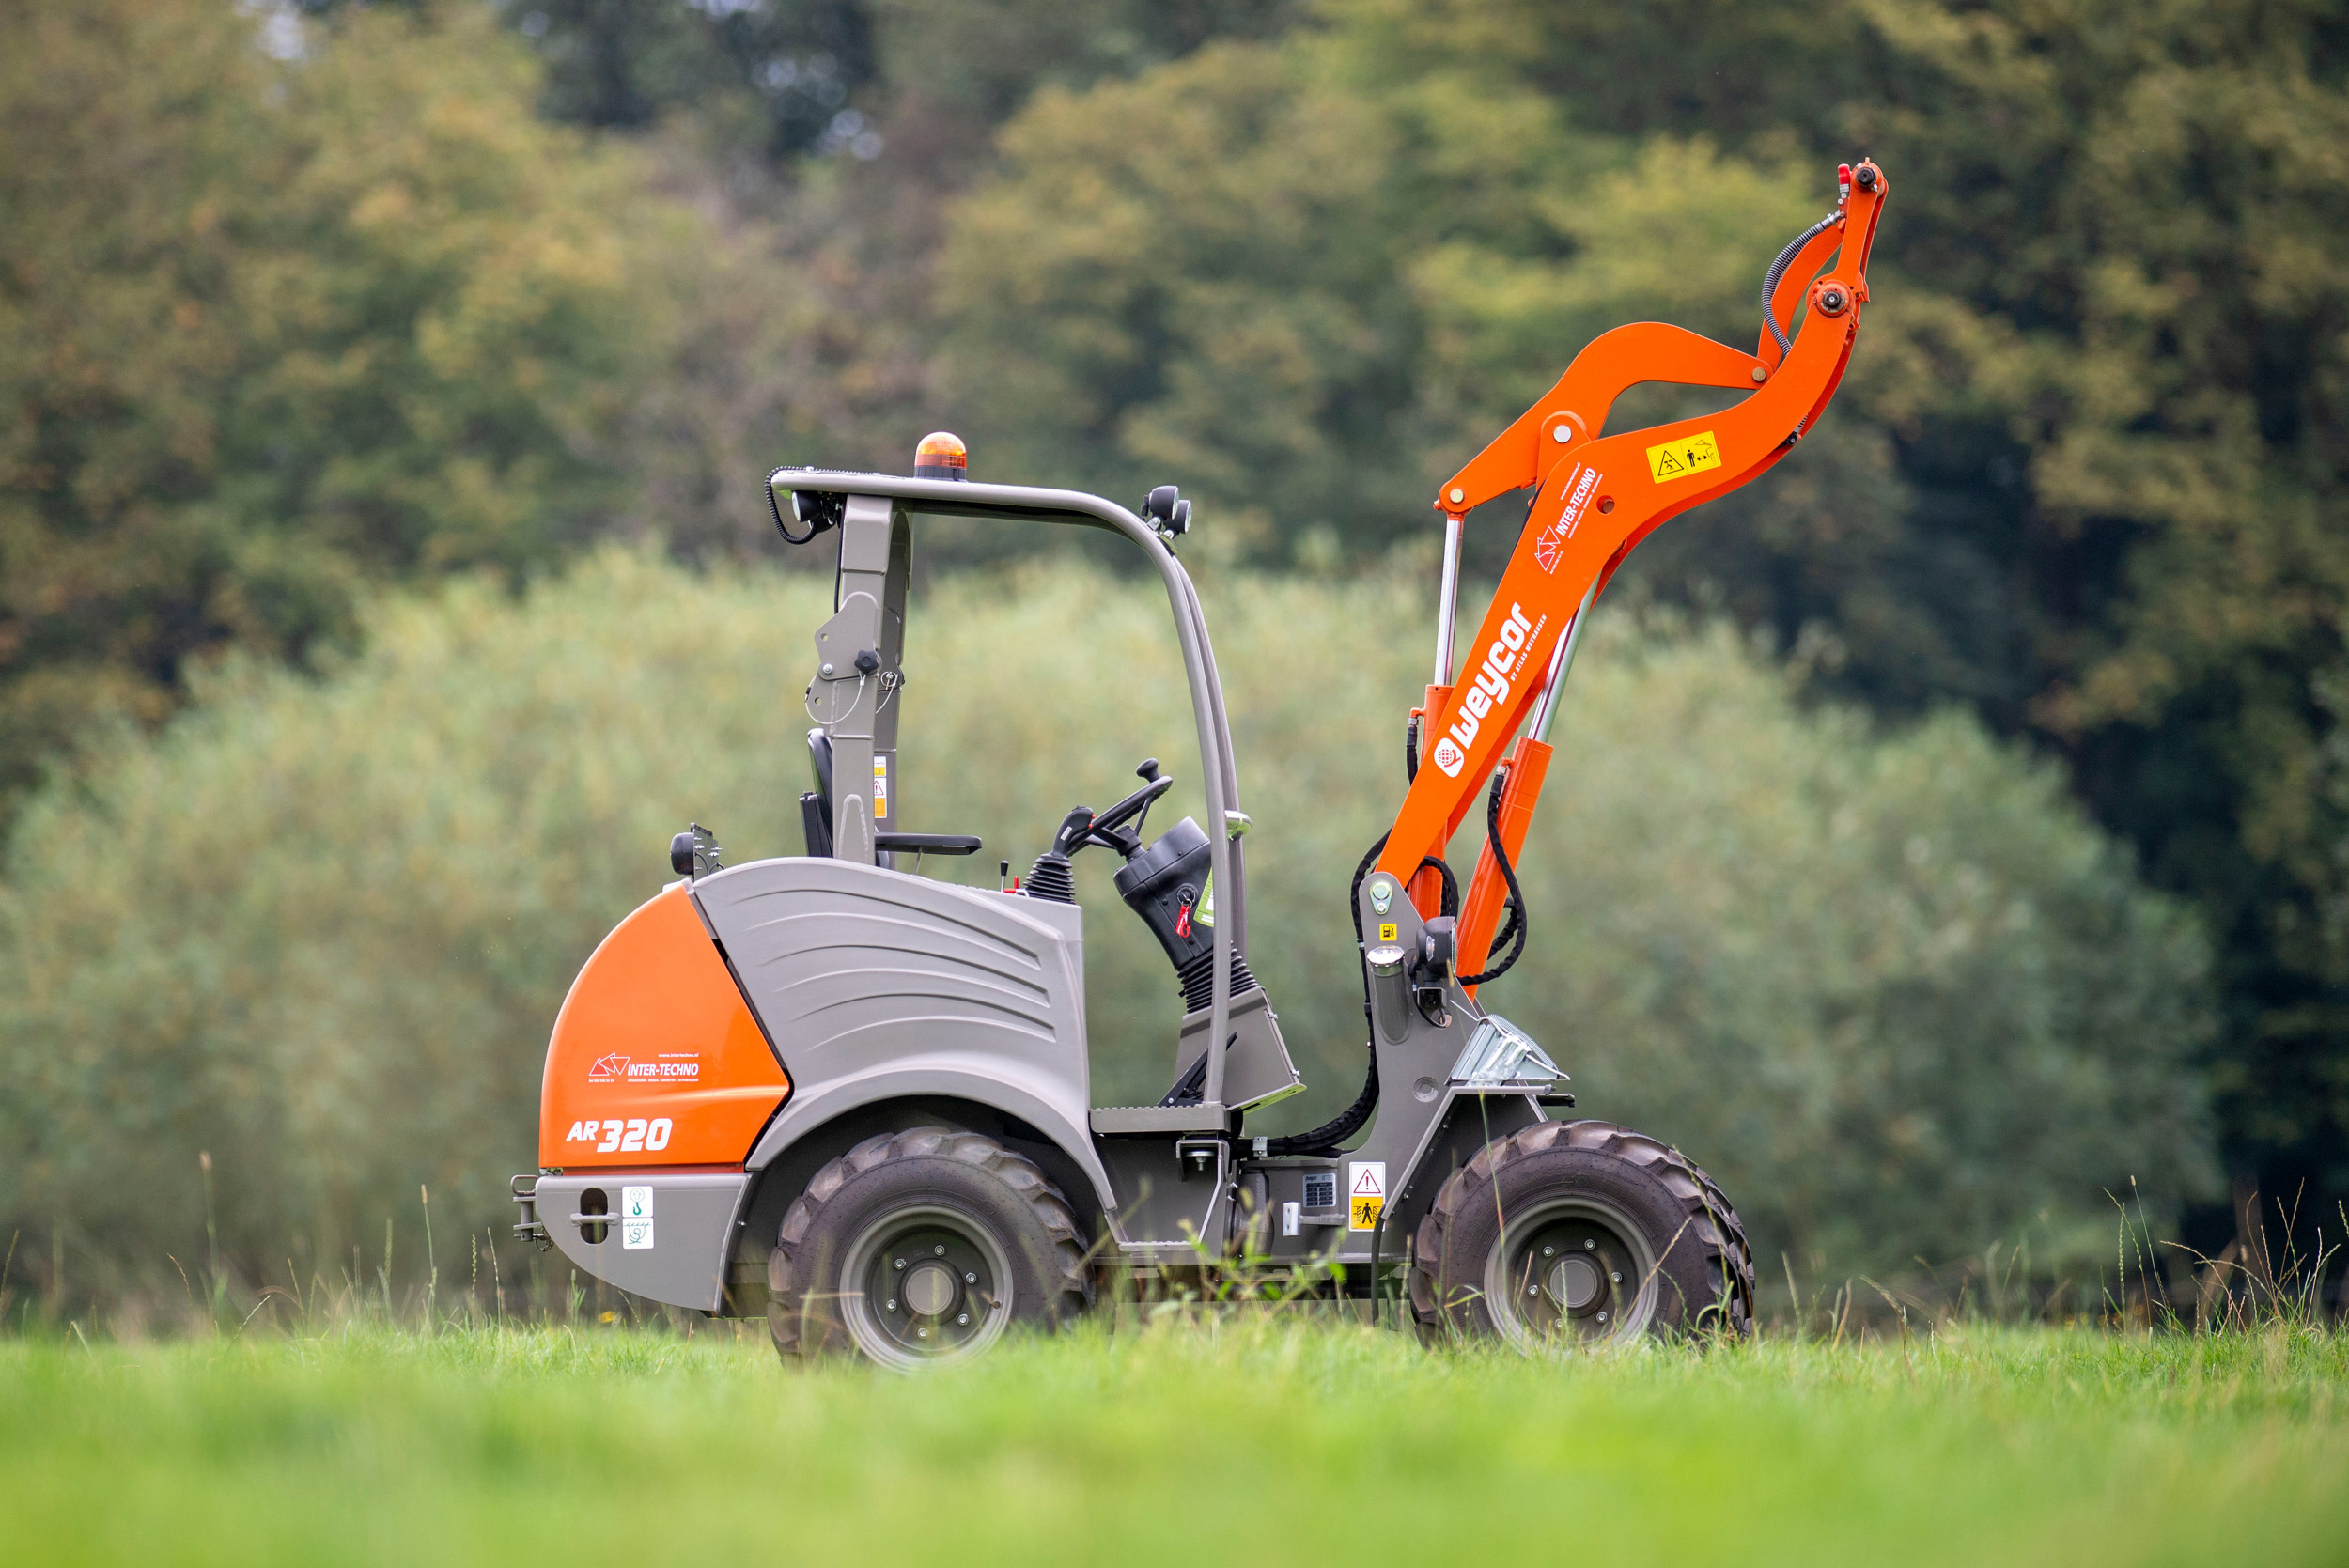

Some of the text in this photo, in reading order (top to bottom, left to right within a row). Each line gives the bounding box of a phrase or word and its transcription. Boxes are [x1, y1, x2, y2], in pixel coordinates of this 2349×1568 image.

[1555, 466, 1596, 536] INTER-TECHNO
[1449, 601, 1532, 750] weycor
[1515, 651, 1528, 674] ATLAS
[1525, 613, 1548, 653] WEYHAUSEN
[627, 1063, 699, 1077] INTER-TECHNO
